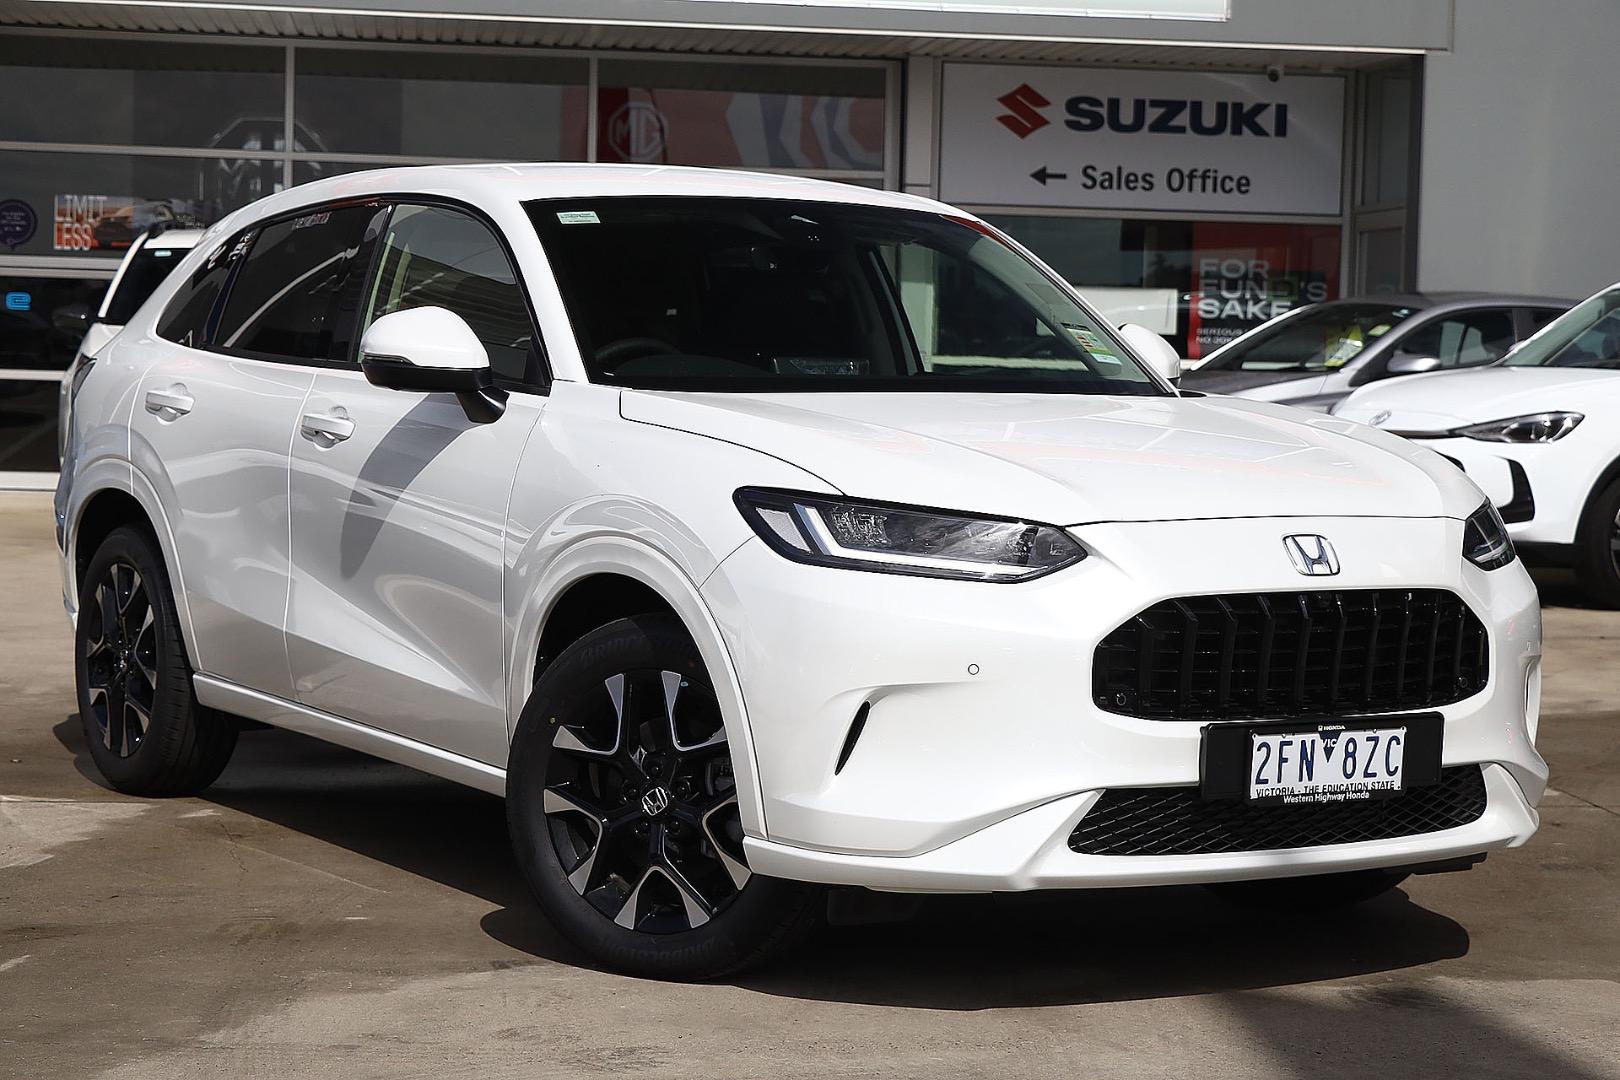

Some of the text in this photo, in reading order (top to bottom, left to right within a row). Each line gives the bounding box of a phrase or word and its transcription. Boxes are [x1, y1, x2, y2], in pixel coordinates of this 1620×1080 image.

[1064, 96, 1288, 137] SUZUKI
[1081, 165, 1250, 194] Sales Office
[54, 194, 107, 222] LIMIT
[54, 222, 92, 251] LESS
[1200, 259, 1269, 278] FOR
[1321, 738, 1338, 748] VIC
[1255, 735, 1402, 785] 2FN 8ZC
[1256, 786, 1295, 798] VICTORIA
[1304, 785, 1320, 794] THE
[1322, 782, 1370, 794] EDUCATION
[1371, 780, 1395, 790] STATE
[1283, 790, 1370, 804] Western Highway Honda
